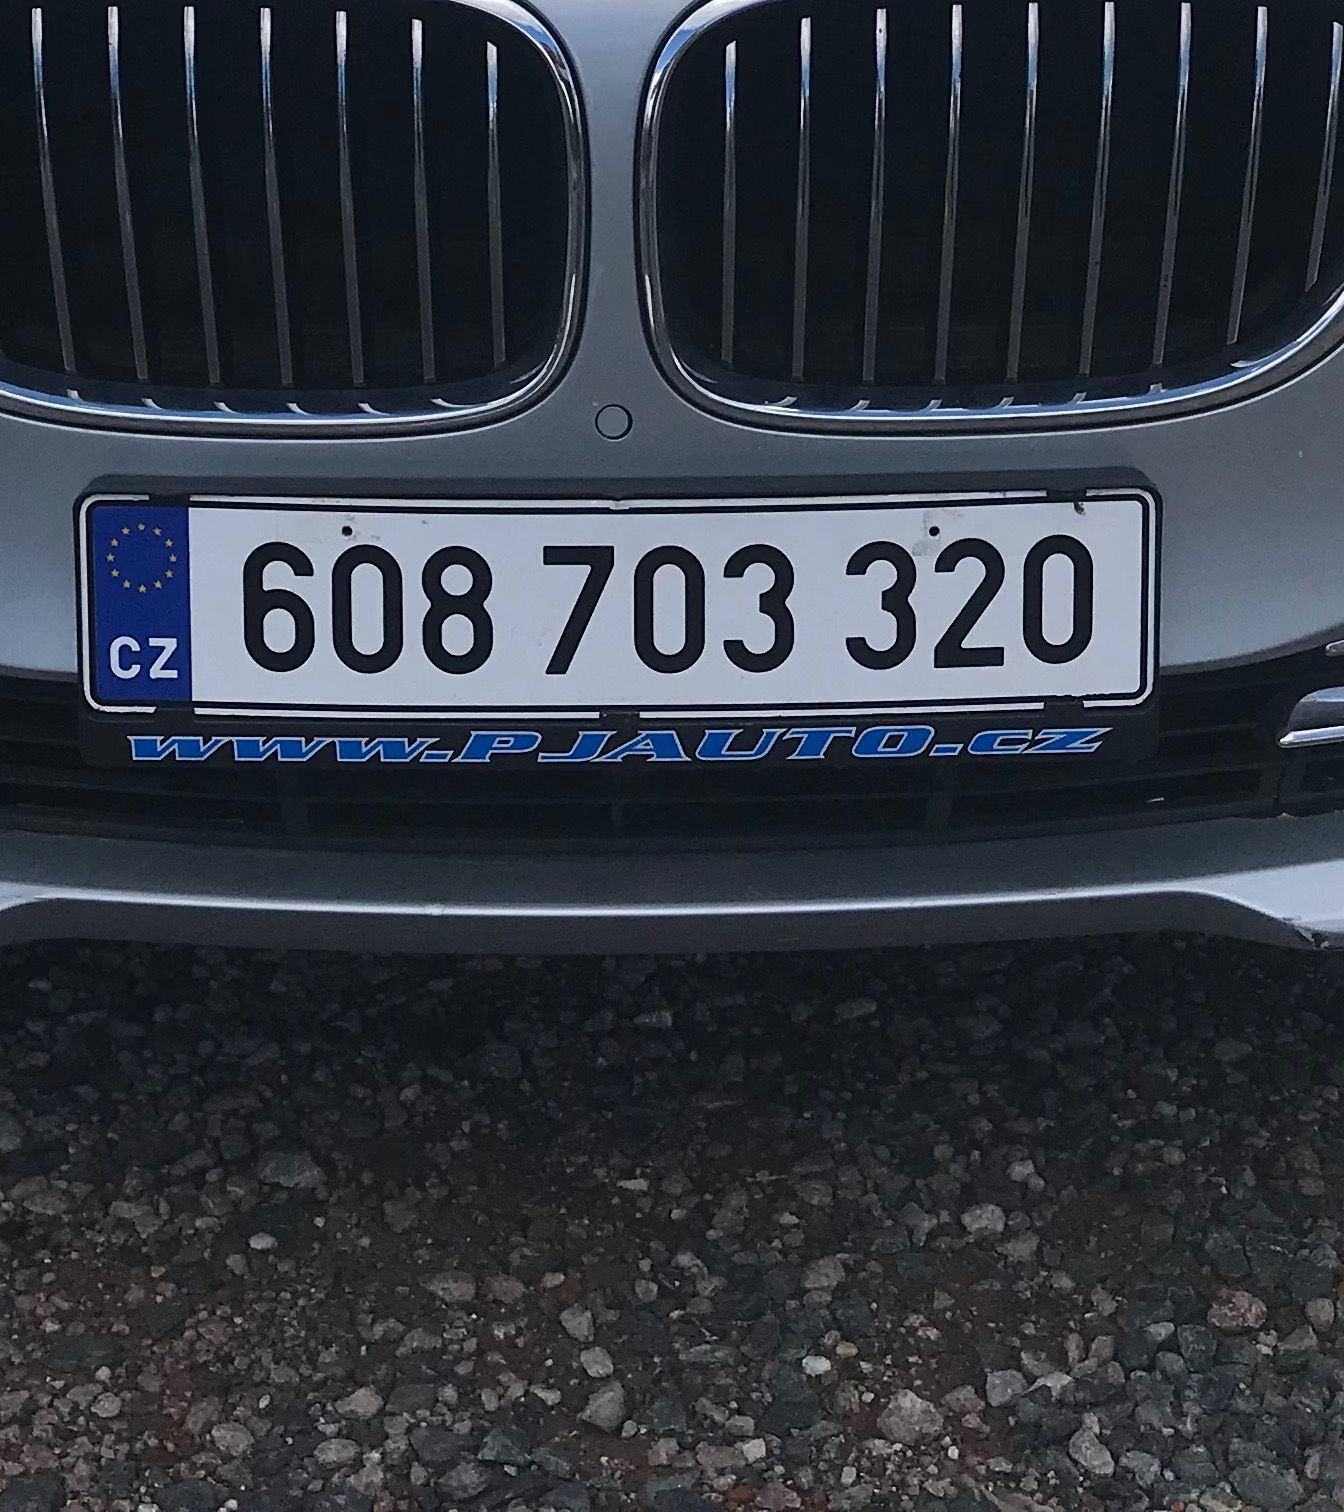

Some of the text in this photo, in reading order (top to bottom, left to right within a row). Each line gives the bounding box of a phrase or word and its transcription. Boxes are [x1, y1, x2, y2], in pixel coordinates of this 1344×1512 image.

[109, 535, 1094, 679] CZ 608 703 320
